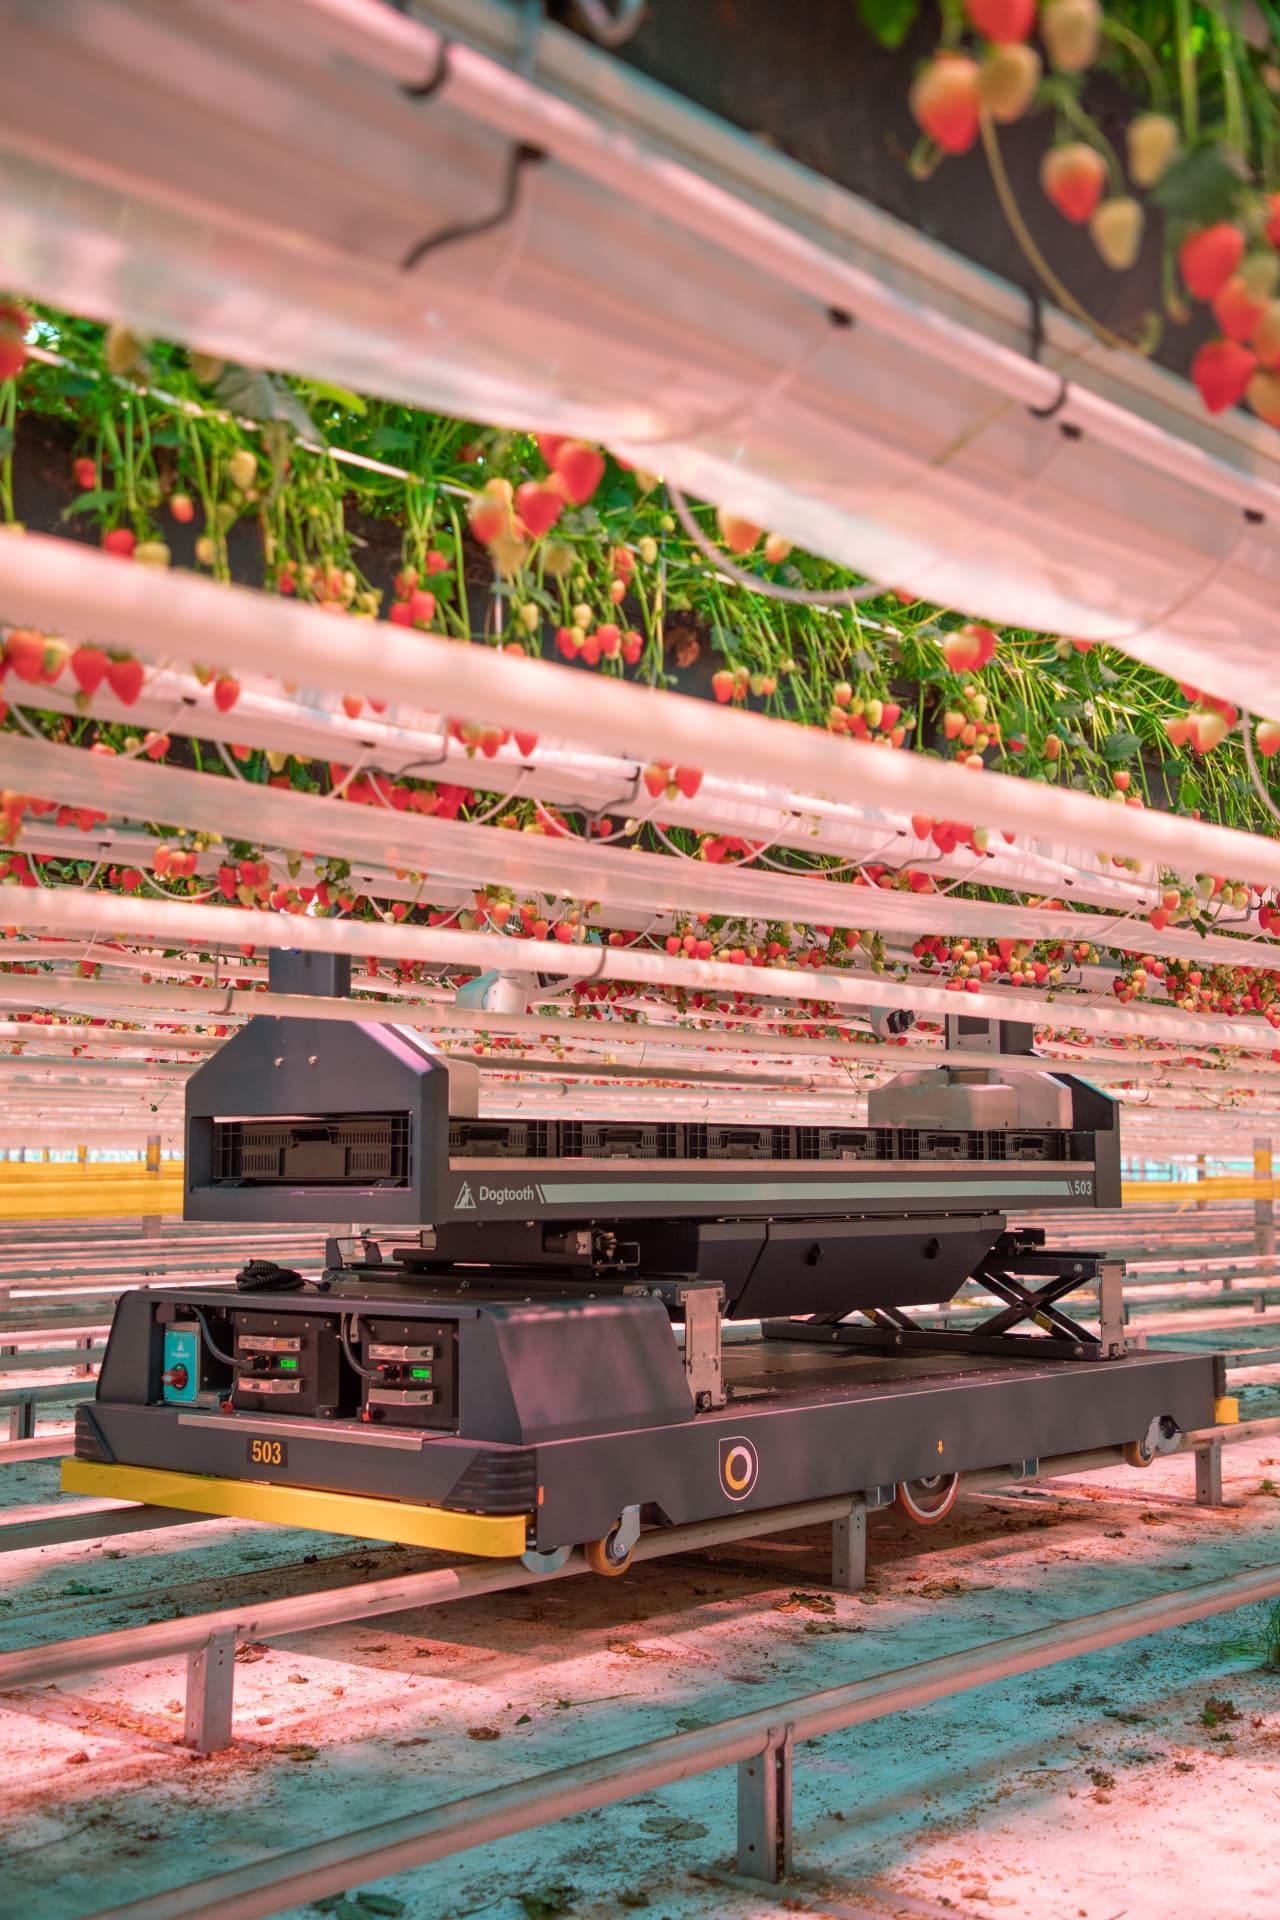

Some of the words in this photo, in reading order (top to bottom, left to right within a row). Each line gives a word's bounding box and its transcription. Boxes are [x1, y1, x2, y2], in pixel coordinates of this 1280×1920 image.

[479, 1185, 534, 1205] Dogtooth
[1074, 1180, 1092, 1195] 503
[252, 1439, 282, 1465] 503
